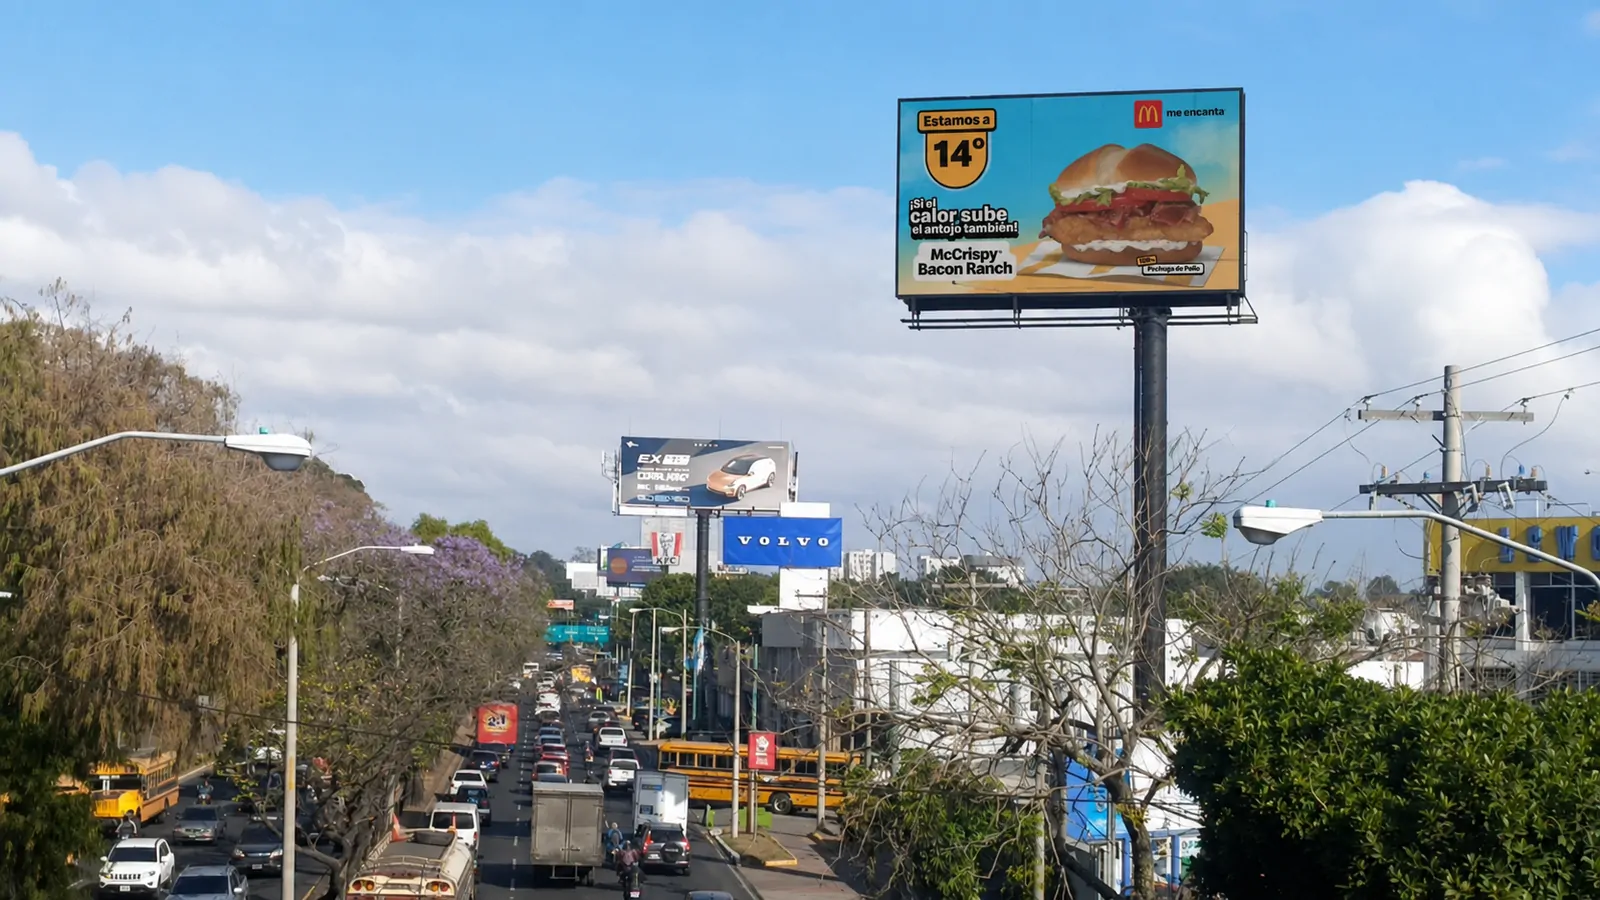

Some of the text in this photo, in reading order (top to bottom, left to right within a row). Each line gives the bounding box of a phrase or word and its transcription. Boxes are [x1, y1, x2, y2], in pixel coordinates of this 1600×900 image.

[1167, 108, 1225, 117] me encanta
[924, 116, 990, 127] Estamos a
[911, 198, 936, 211] ¡Si el
[910, 206, 1008, 224] calor sube
[913, 222, 1018, 236] el antojo también!
[918, 262, 1013, 276] Bacon Ranch
[638, 454, 662, 464] EX
[738, 536, 829, 547] VOLVO
